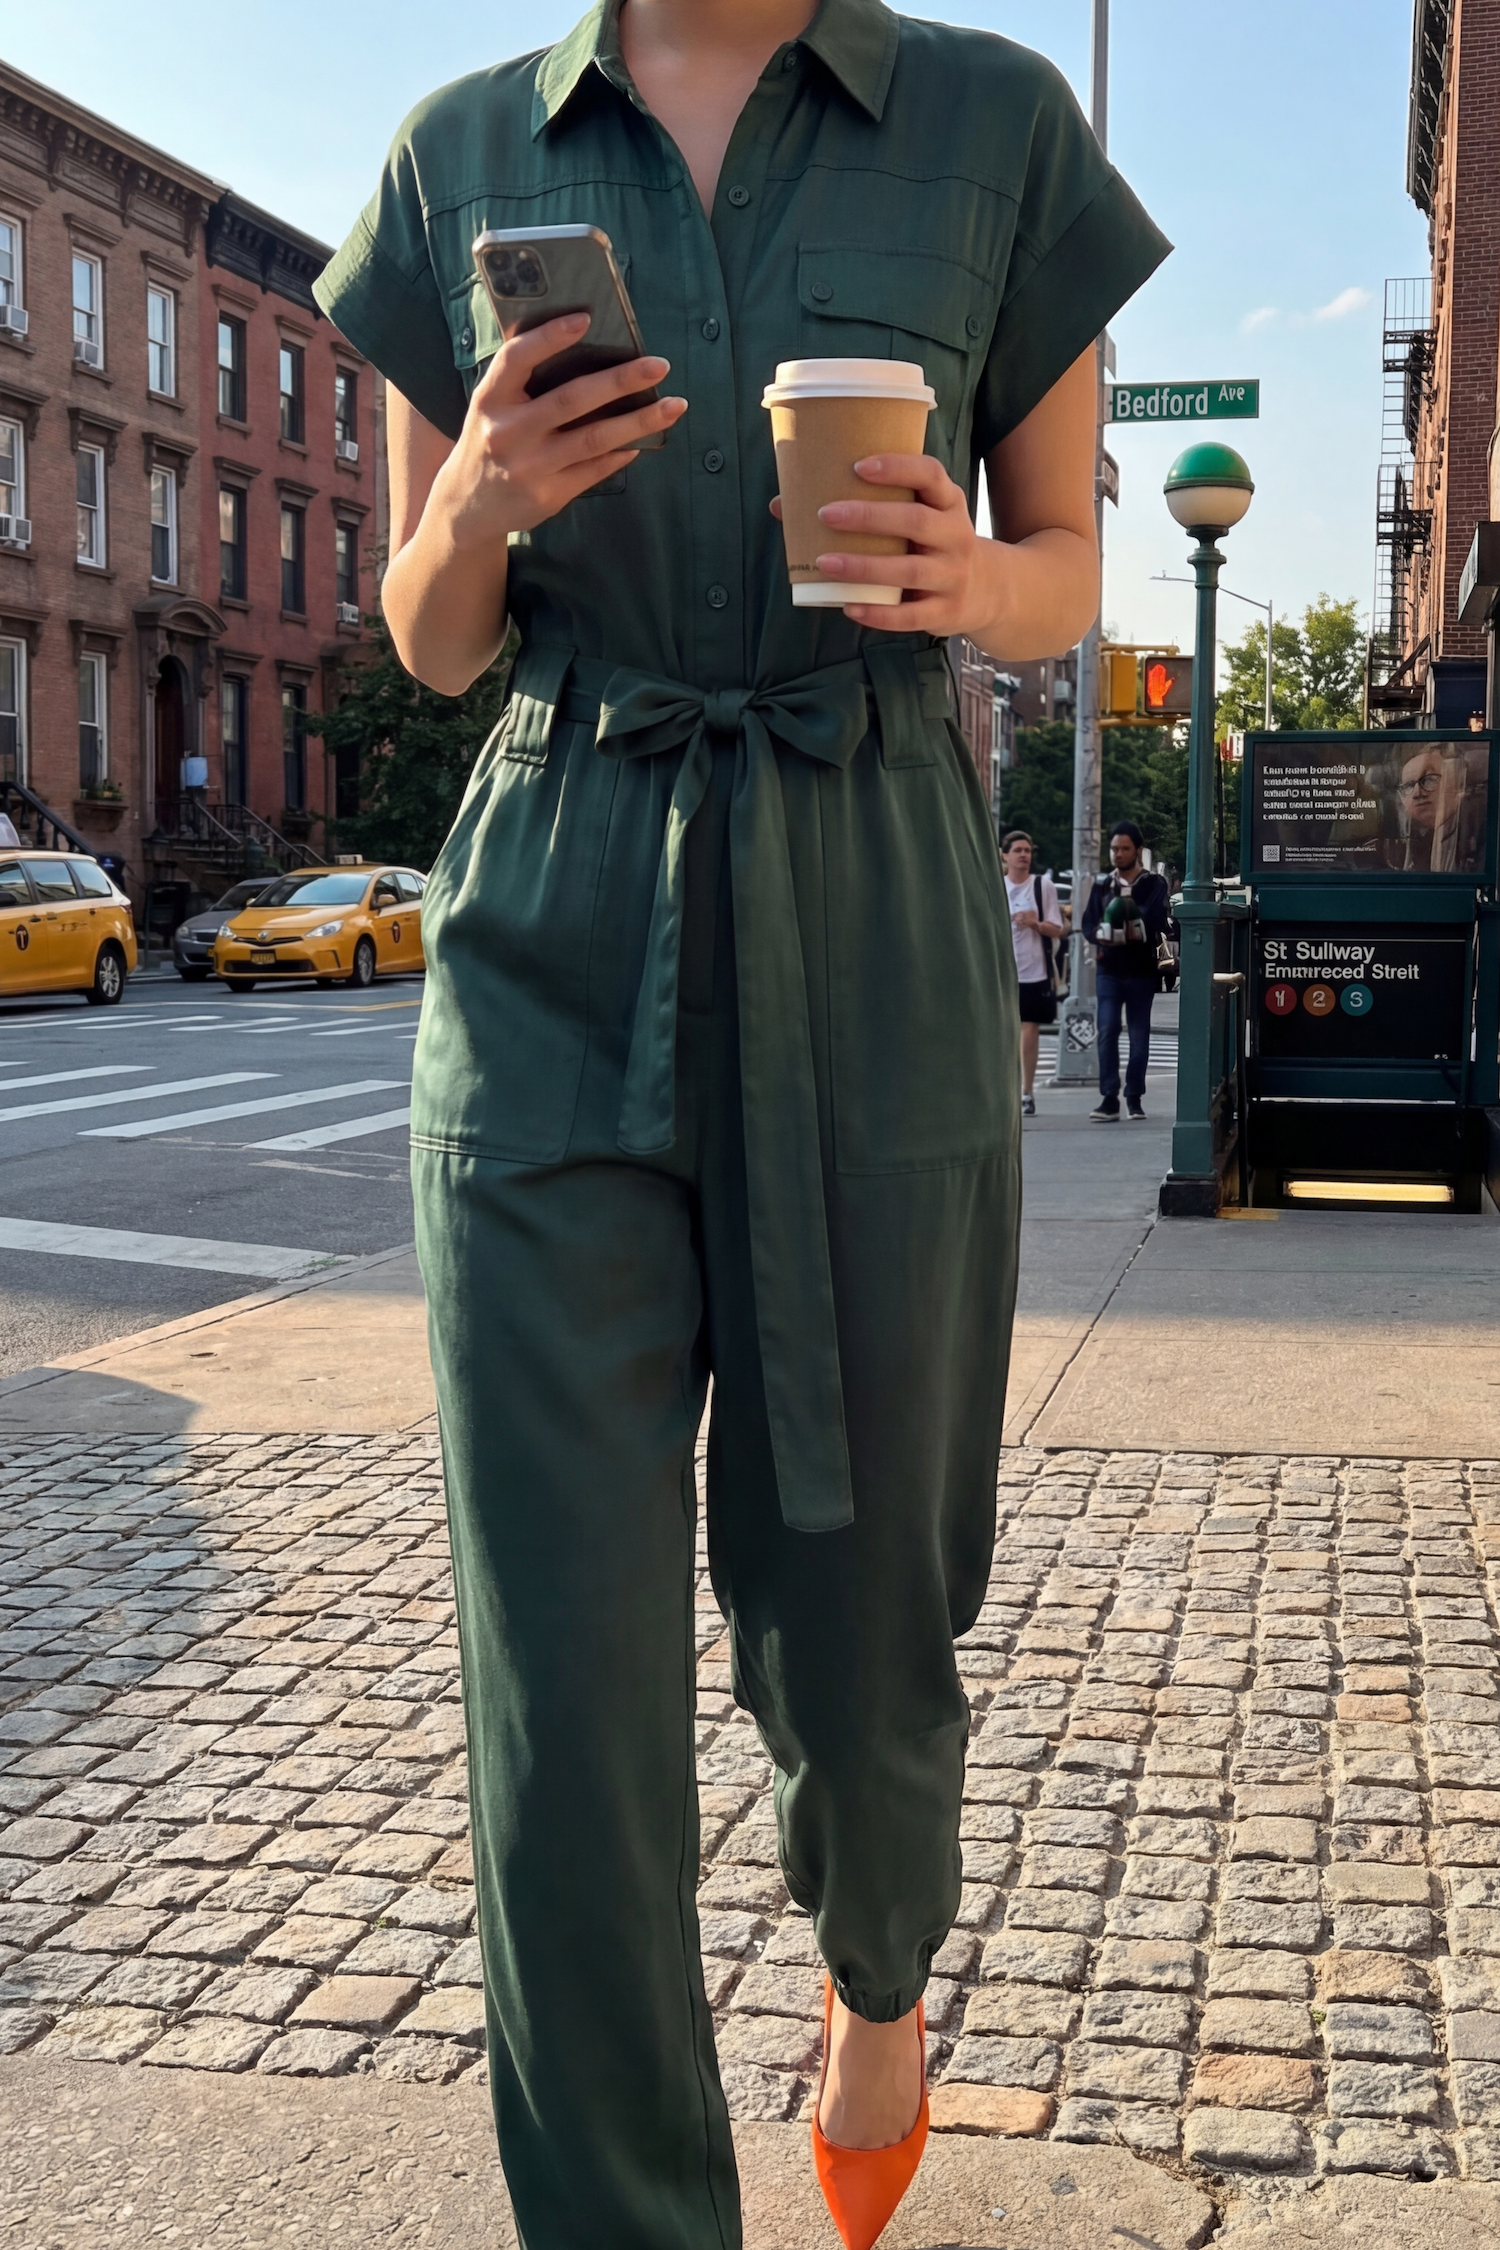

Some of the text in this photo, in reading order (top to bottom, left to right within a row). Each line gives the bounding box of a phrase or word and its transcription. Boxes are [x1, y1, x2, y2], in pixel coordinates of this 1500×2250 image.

[1117, 384, 1245, 418] Bedford Ave
[1263, 940, 1288, 960] St
[1312, 990, 1326, 1008] 2
